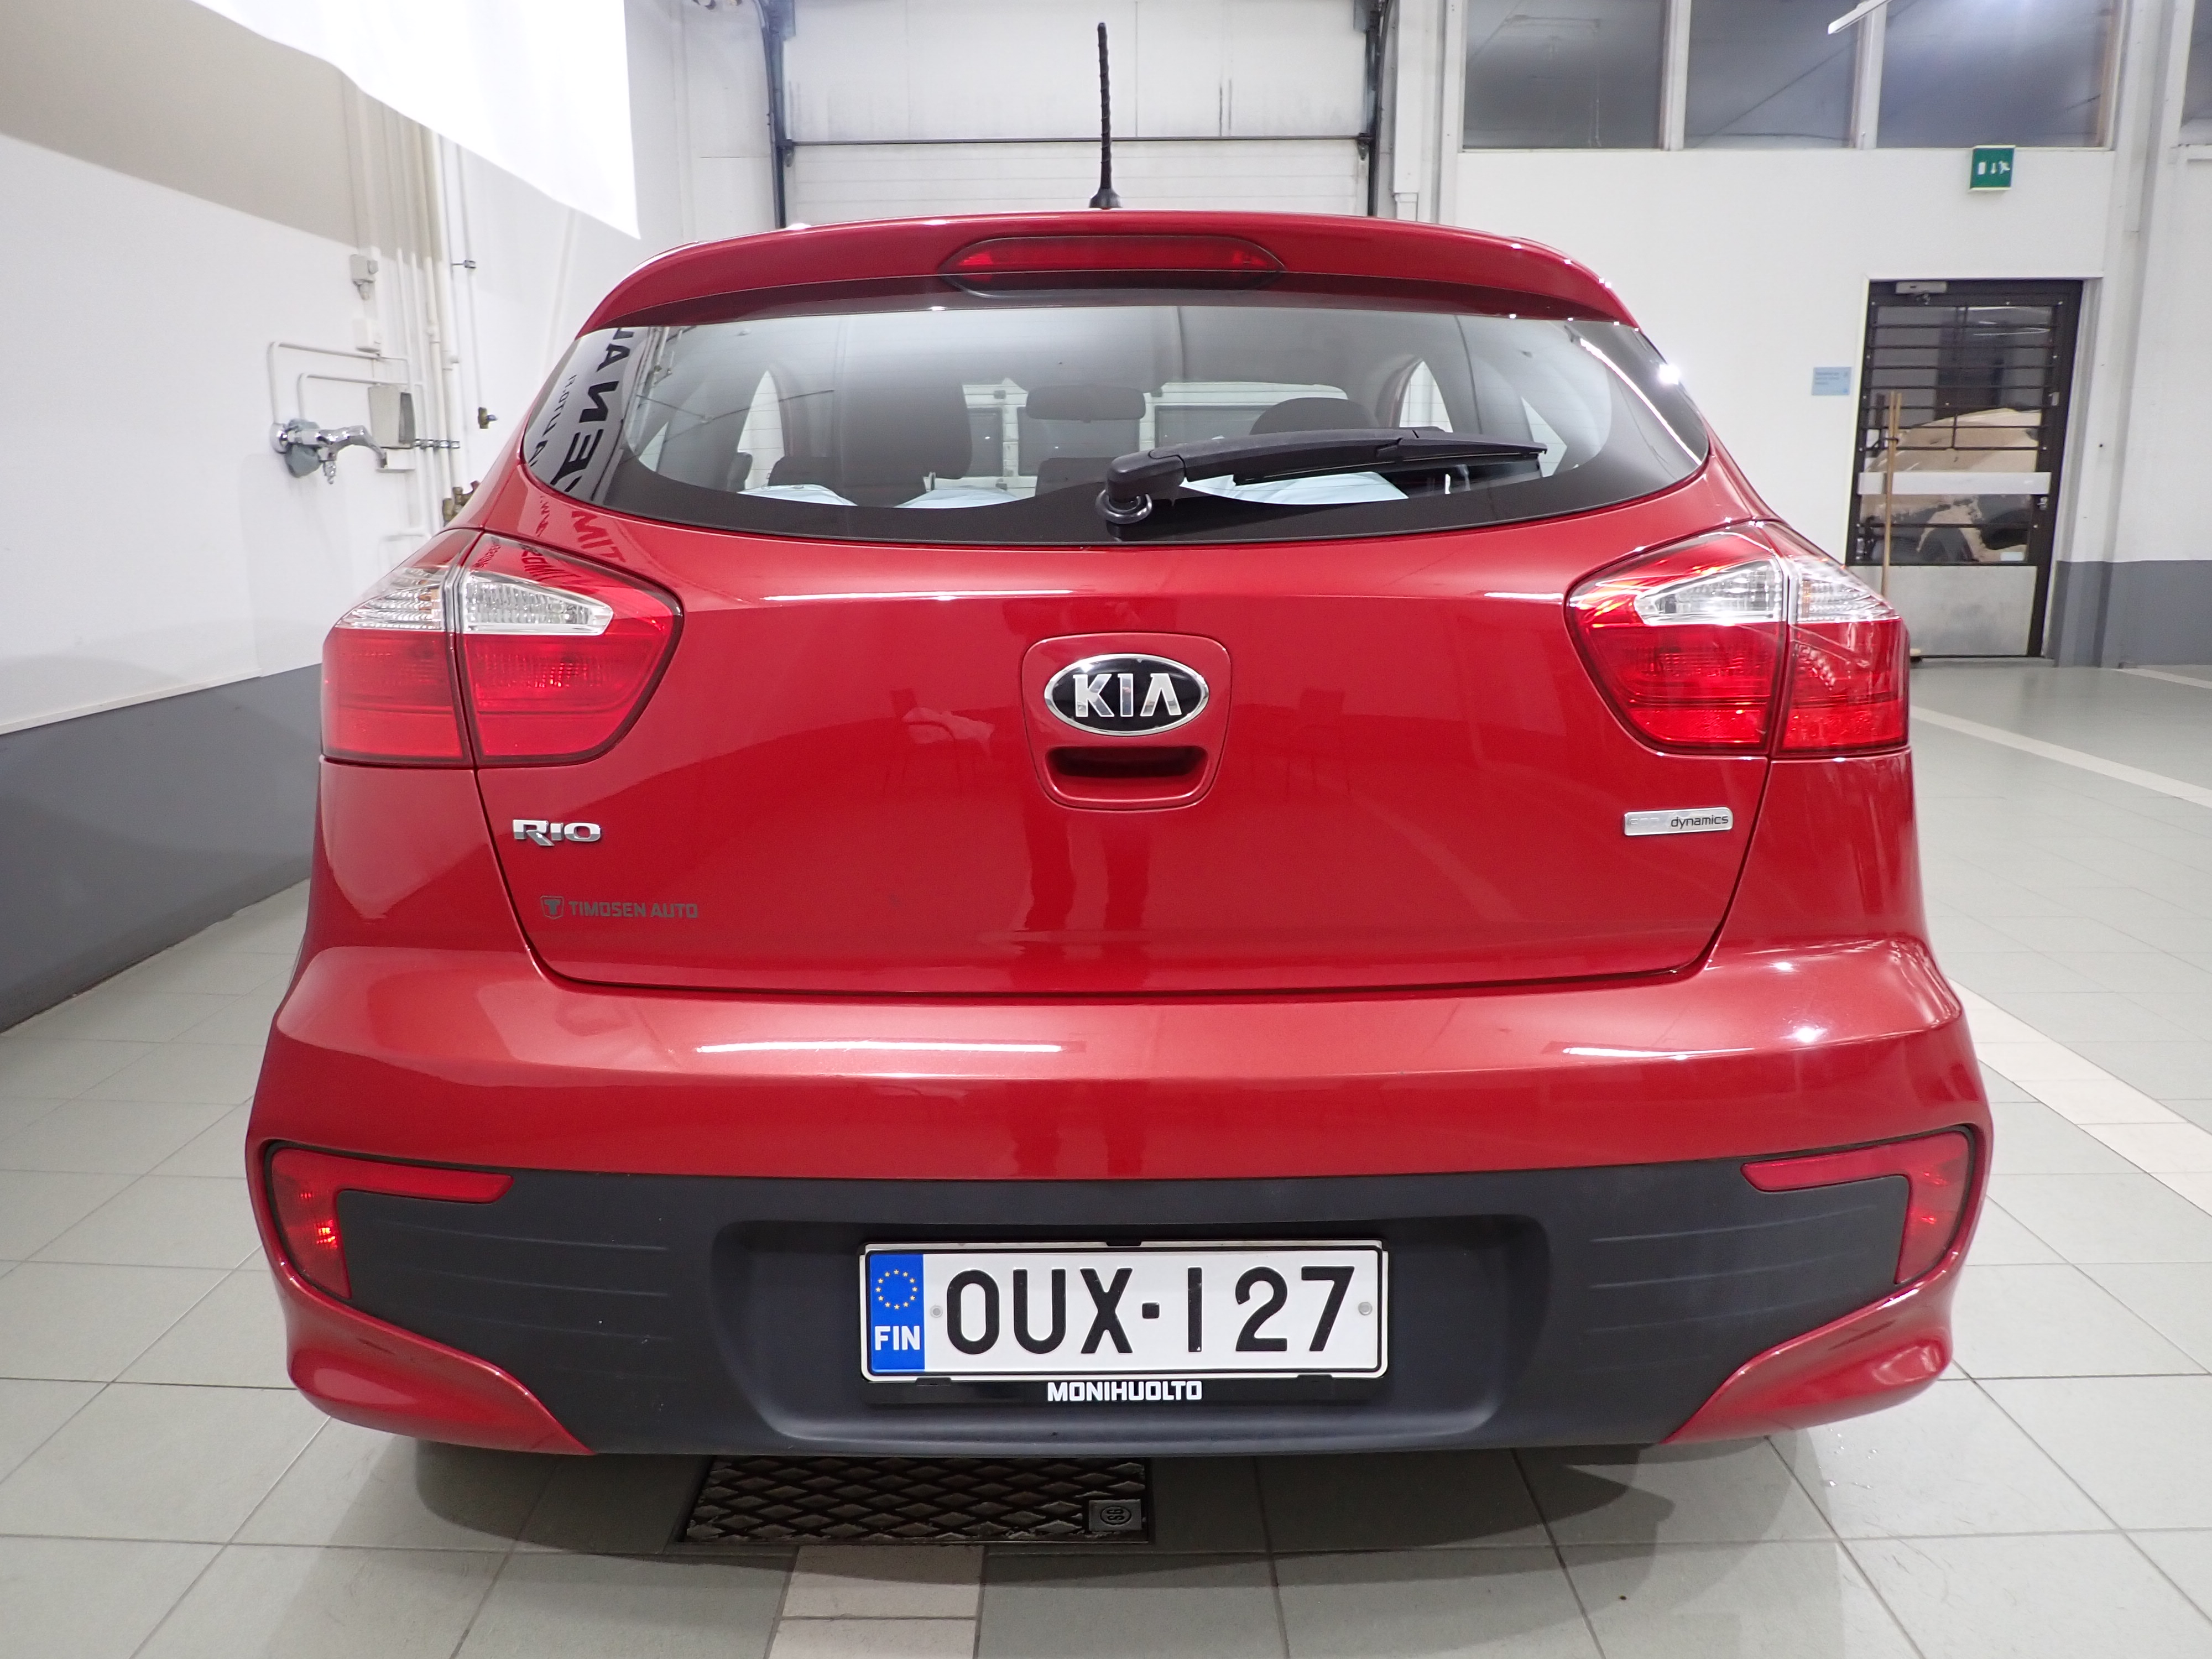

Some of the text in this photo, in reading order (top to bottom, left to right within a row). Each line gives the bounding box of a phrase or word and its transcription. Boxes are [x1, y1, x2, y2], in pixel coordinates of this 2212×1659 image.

[1073, 673, 1182, 717] KIA
[513, 819, 601, 847] RIO
[1671, 815, 1729, 829] dynamics
[568, 901, 698, 919] TIMOSEN AUTO
[946, 1265, 1355, 1355] OUX-127
[874, 1325, 920, 1350] FIN
[1047, 1381, 1202, 1402] MONIHUOLTO
